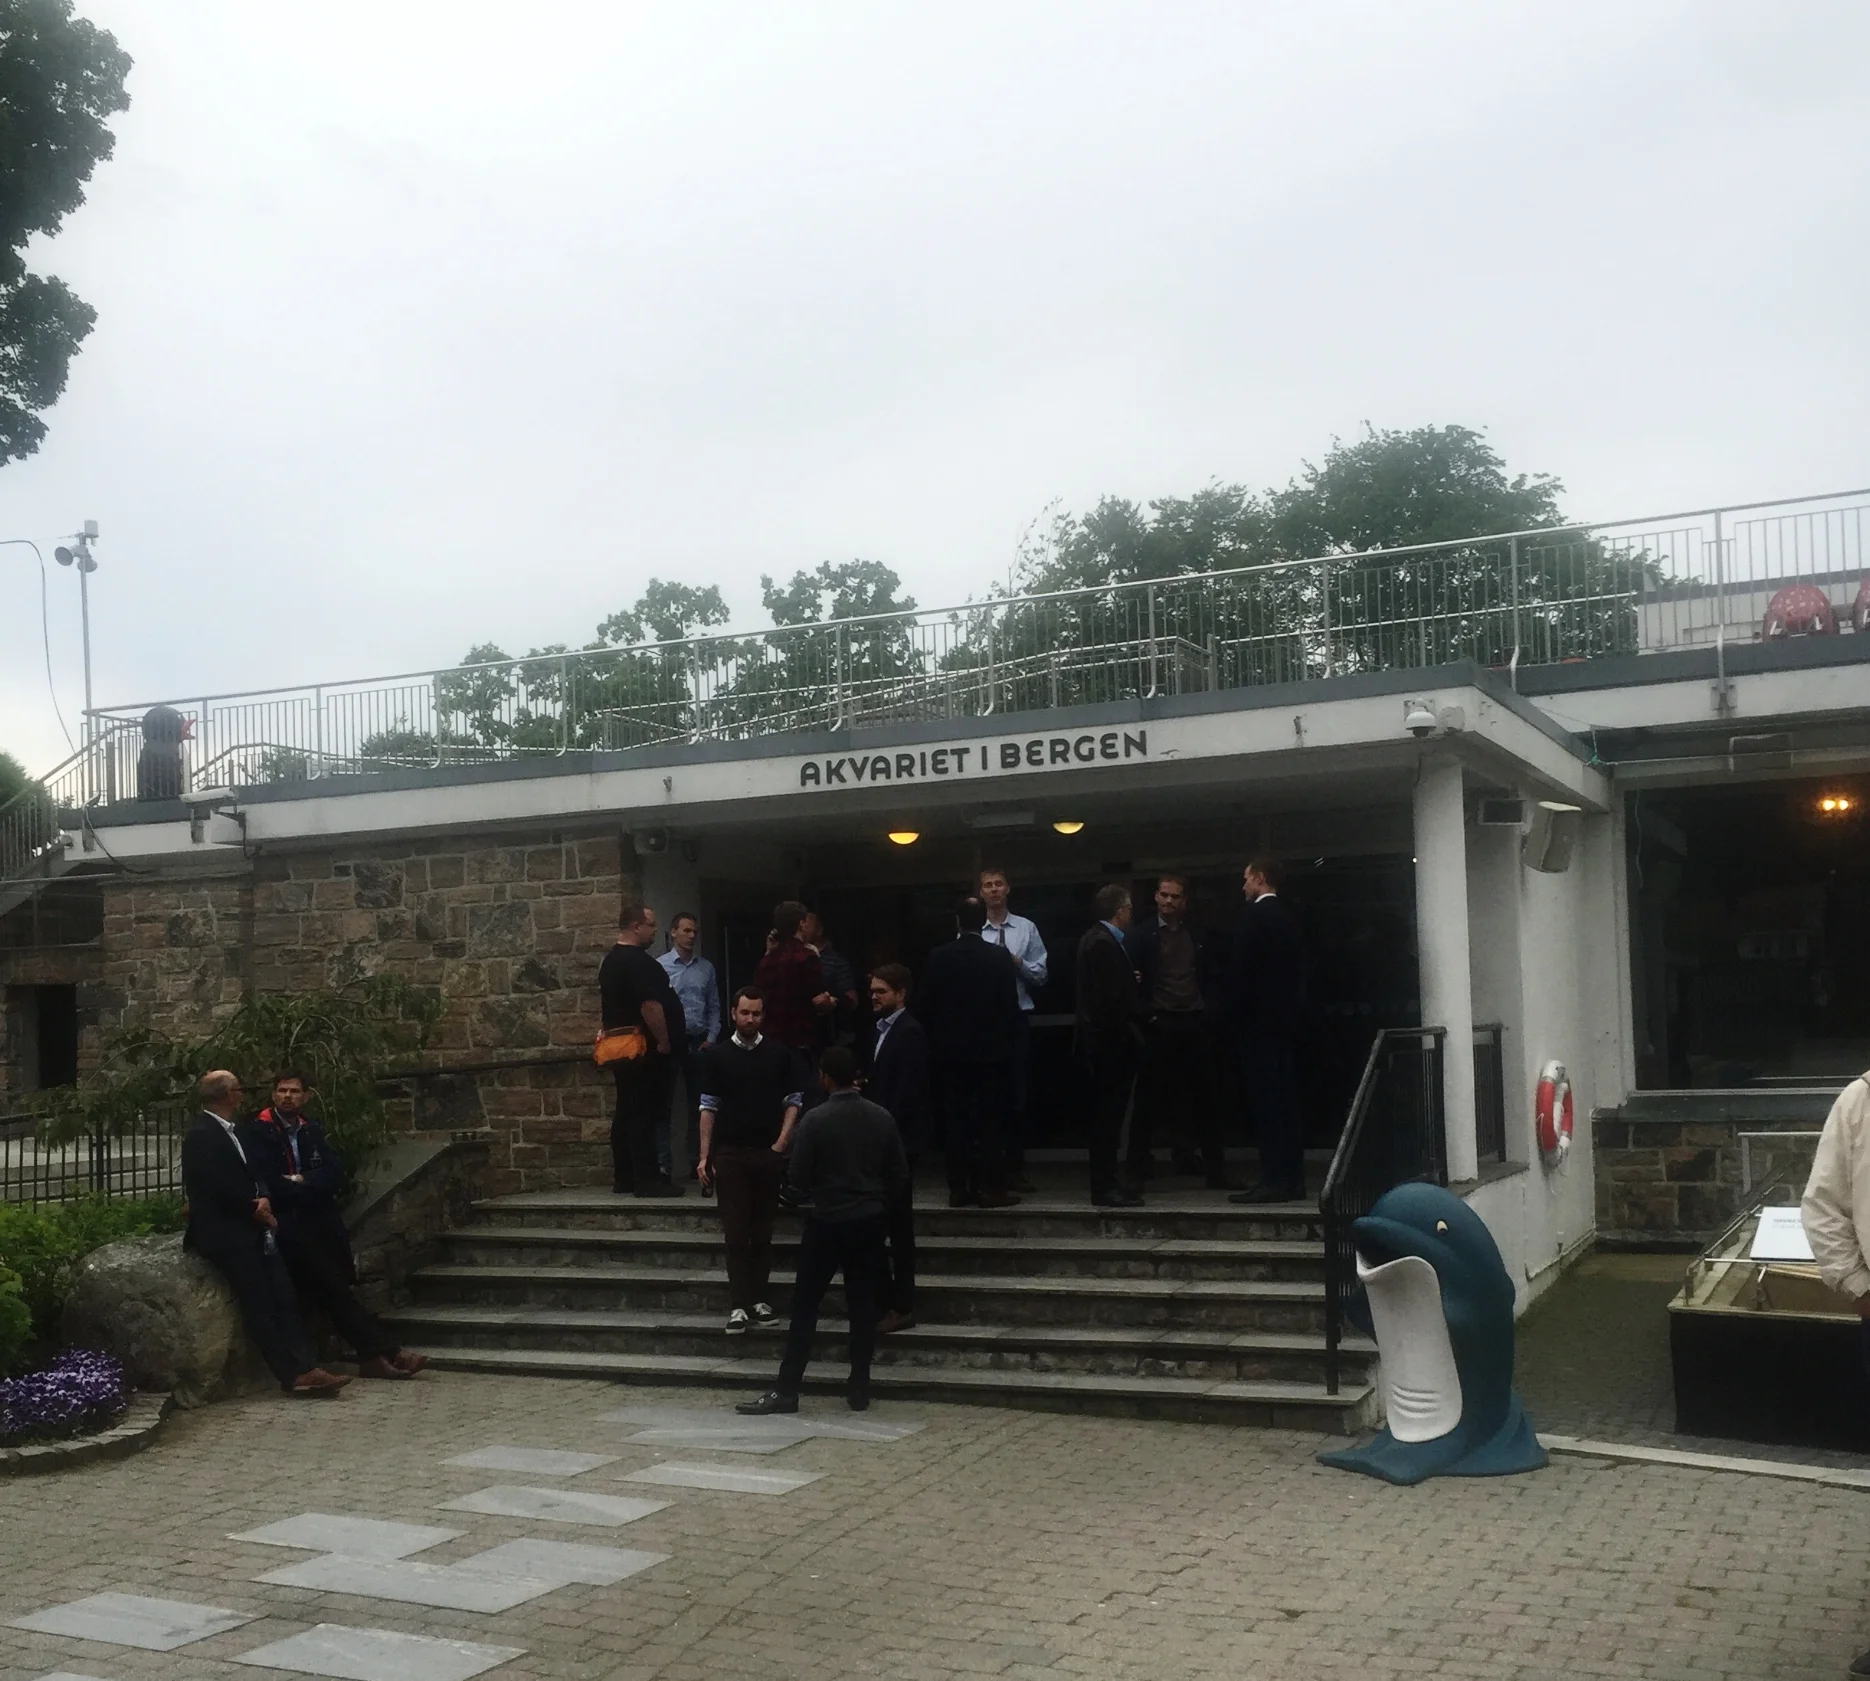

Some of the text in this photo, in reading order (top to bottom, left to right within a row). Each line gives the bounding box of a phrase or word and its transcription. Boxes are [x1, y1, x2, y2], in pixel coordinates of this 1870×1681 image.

[800, 730, 1147, 786] AKVARIET I BERGEN
